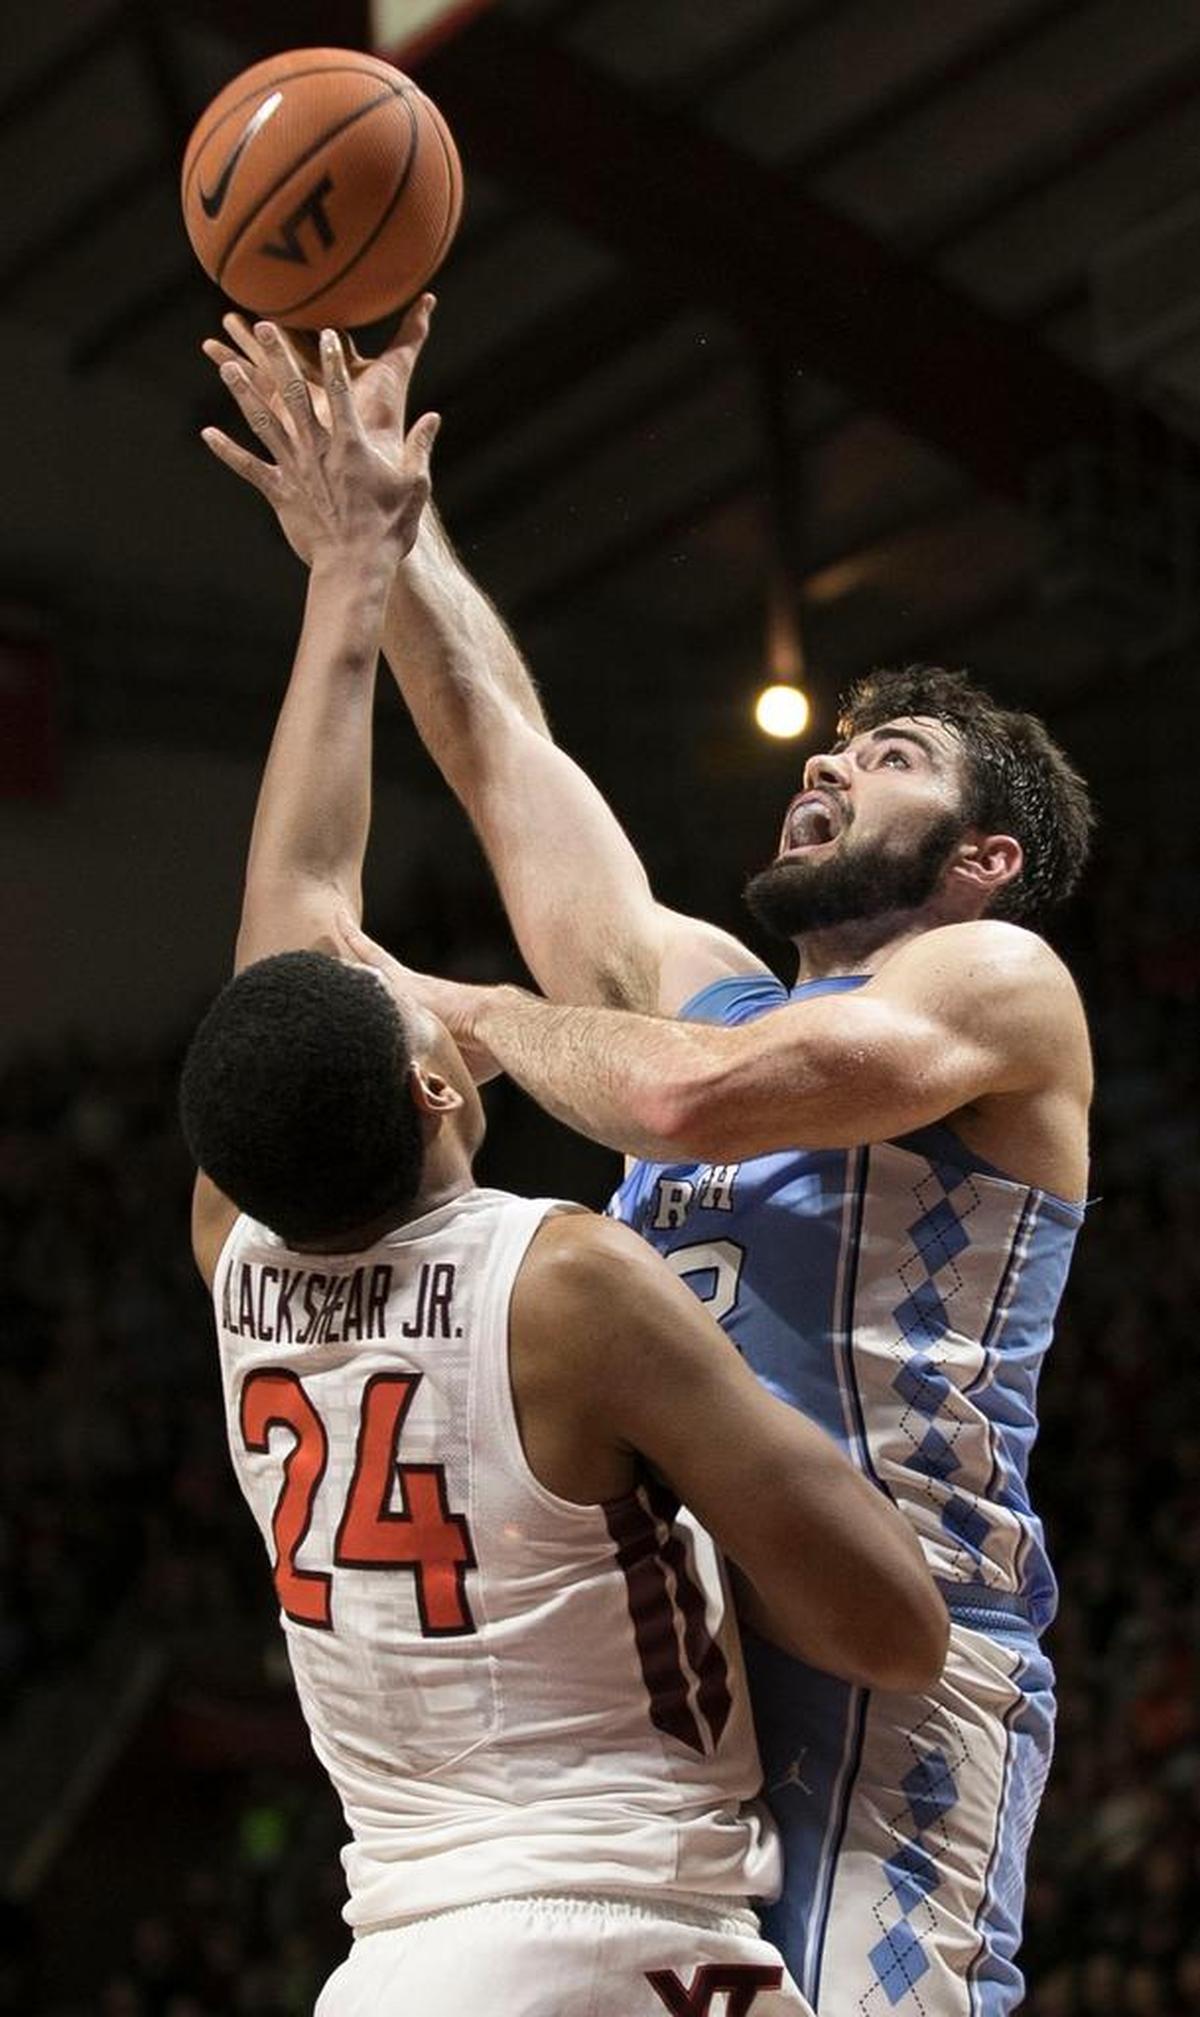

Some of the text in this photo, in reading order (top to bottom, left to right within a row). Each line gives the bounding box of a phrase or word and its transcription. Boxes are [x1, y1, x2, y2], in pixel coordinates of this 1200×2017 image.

[257, 176, 336, 266] VT
[223, 1260, 463, 1345] LACKSHEAR JR.
[240, 1366, 478, 1638] 24
[644, 1963, 784, 2017] VT
